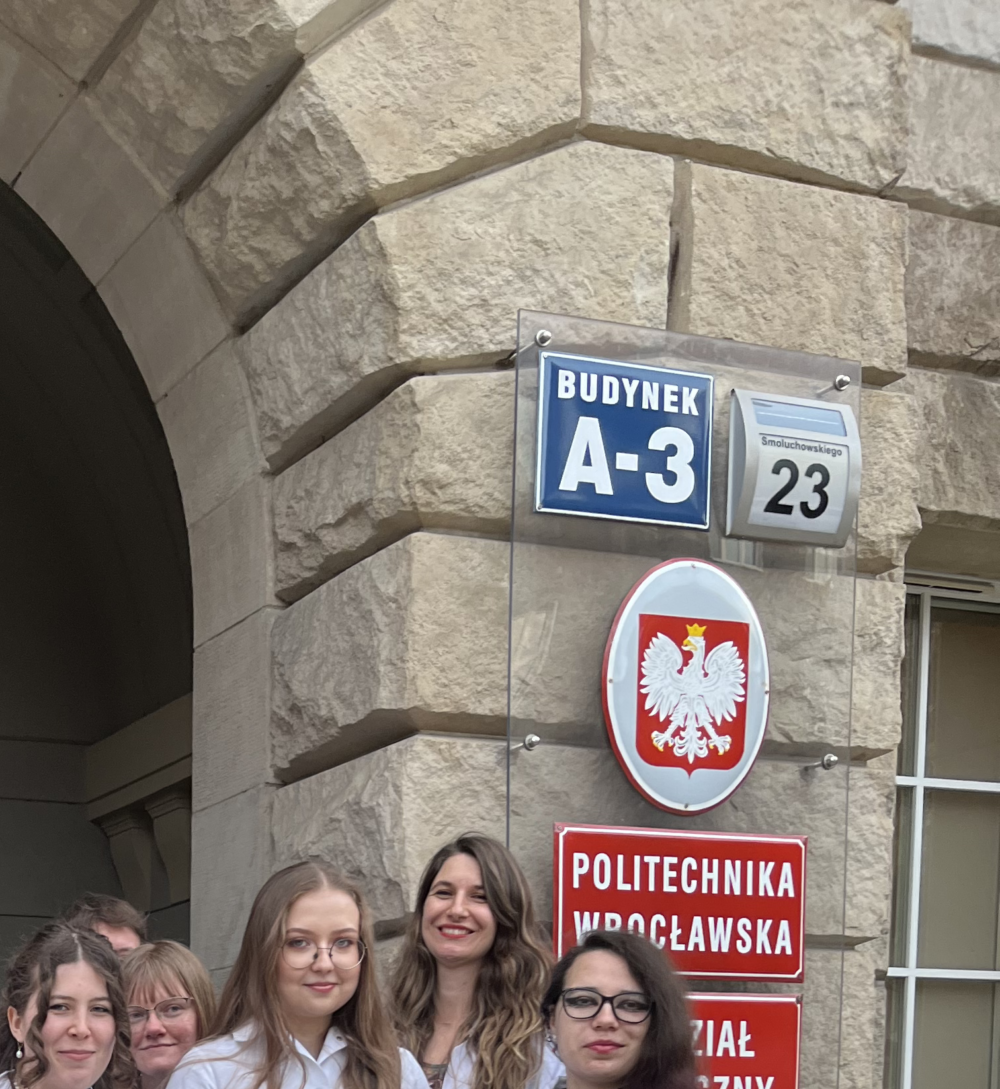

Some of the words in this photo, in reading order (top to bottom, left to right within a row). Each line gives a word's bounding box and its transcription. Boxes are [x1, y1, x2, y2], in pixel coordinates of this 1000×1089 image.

[558, 369, 699, 416] BUDYNEK
[558, 416, 695, 503] A-3
[761, 436, 842, 457] Smoluchowskiego
[763, 458, 830, 519] 23
[572, 852, 795, 898] POLITECHNIKA
[690, 1019, 756, 1057] ZIAŁ
